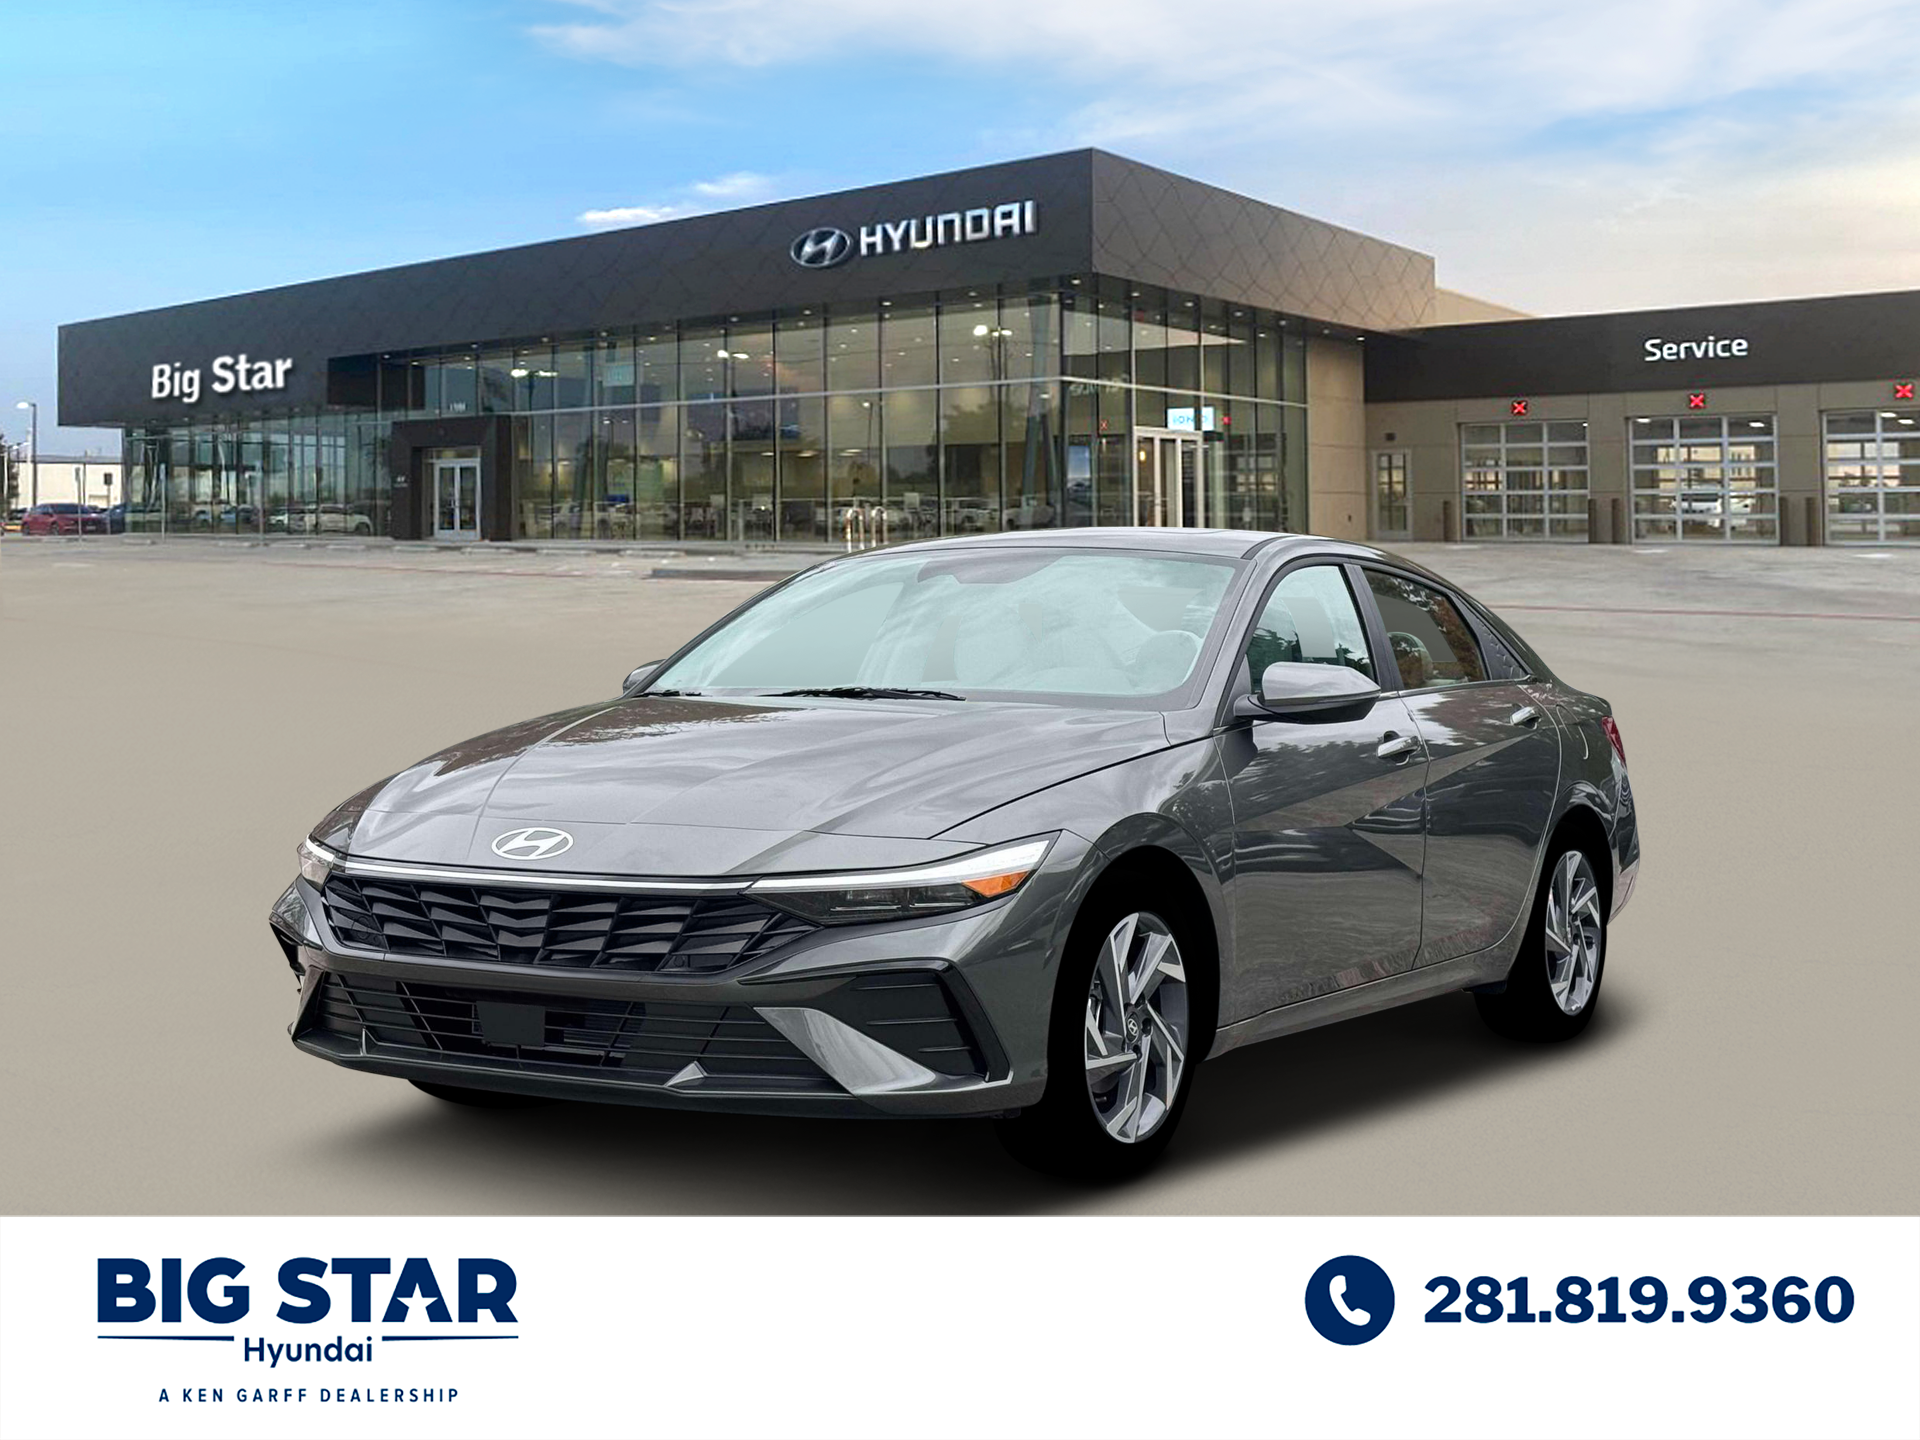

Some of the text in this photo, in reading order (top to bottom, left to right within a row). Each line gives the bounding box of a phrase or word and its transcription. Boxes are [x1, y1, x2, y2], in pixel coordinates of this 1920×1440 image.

[860, 200, 1036, 256] HYUNDAI
[1644, 336, 1749, 362] Service
[152, 354, 293, 403] Big Star
